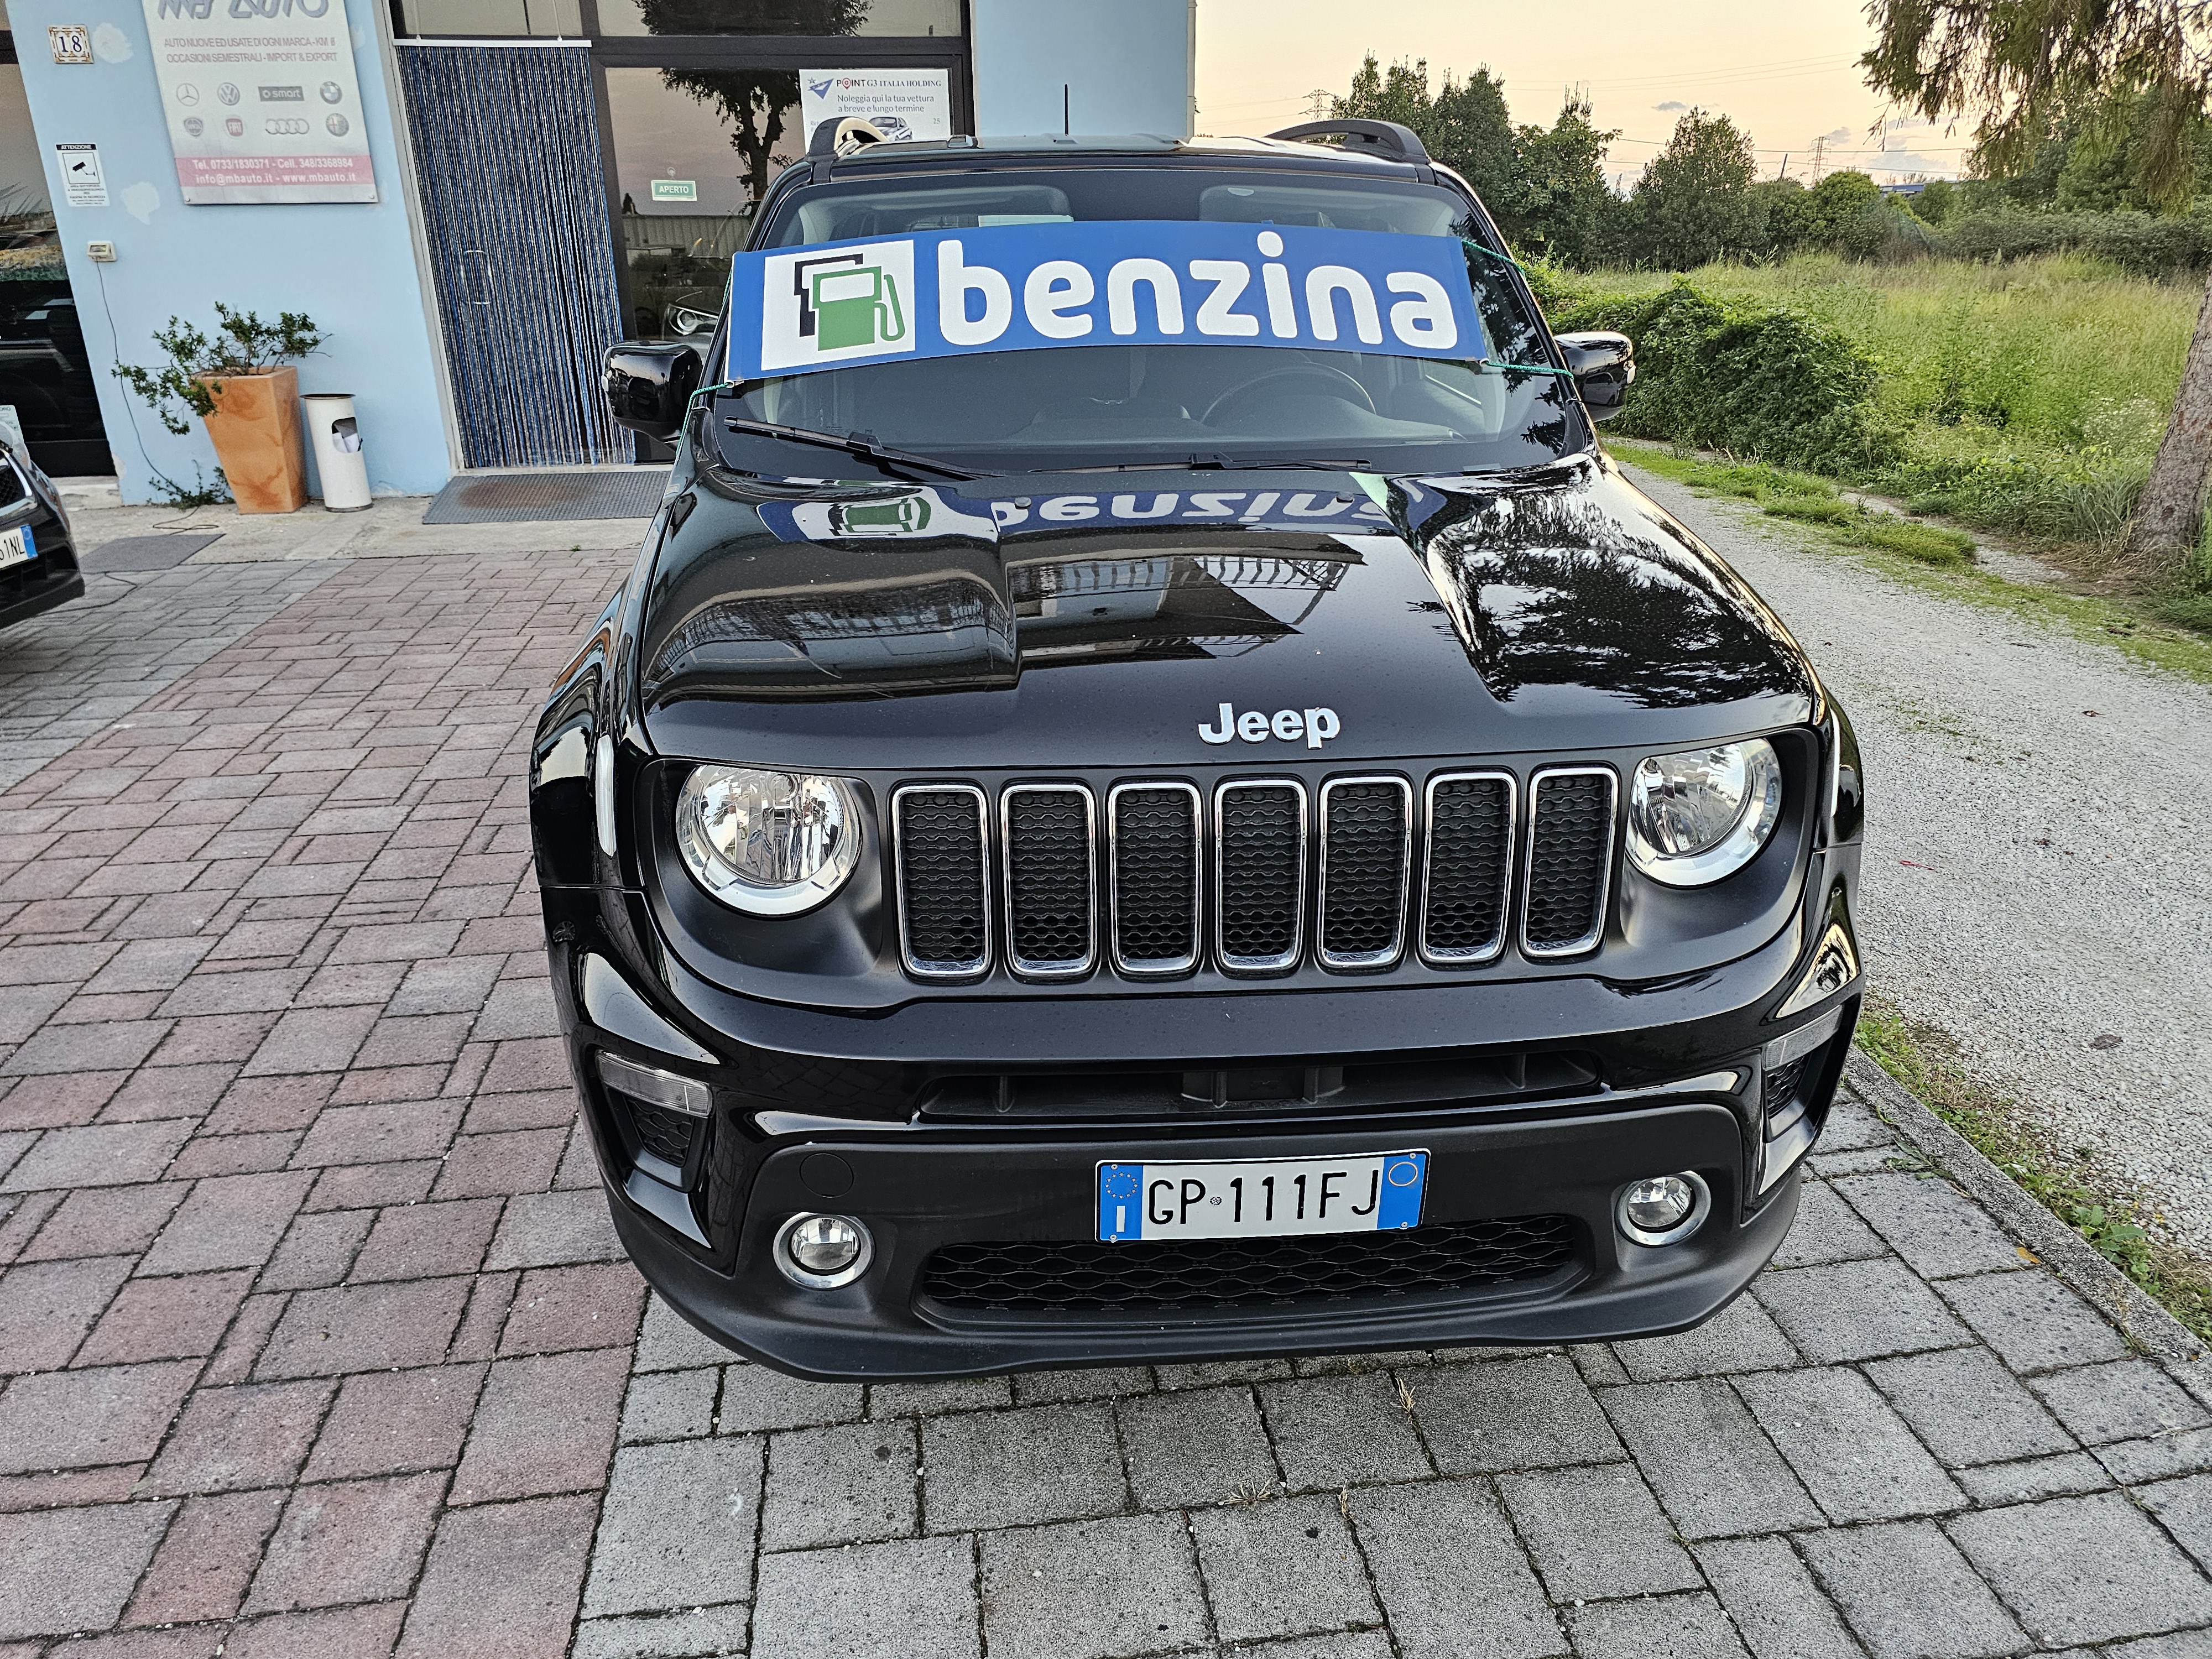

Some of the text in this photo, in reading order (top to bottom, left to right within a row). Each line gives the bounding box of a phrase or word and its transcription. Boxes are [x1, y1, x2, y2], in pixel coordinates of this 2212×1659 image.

[59, 35, 82, 53] 18
[165, 38, 186, 48] AUTO
[186, 38, 215, 47] NUOVE
[215, 38, 226, 47] ED
[227, 38, 253, 46] USATE
[253, 37, 262, 46] DI
[262, 37, 281, 46] OGNI
[283, 36, 312, 46] MARCA
[166, 53, 211, 62] OCCASIONI
[212, 53, 262, 62] SEMESTRALI
[266, 53, 296, 61] IMPORT
[299, 53, 305, 61] &
[305, 53, 337, 61] EXPORT
[837, 77, 865, 90] POINT
[272, 89, 301, 98] smart
[837, 94, 870, 103] Noleggia
[872, 94, 884, 103] qui
[873, 105, 894, 113] lungo
[191, 159, 209, 170] Tel.
[210, 159, 269, 170] 0733/1830371
[277, 158, 298, 169] Cell.
[299, 158, 353, 168] 348/3368984
[196, 173, 273, 185] info@mbauto.it
[282, 172, 356, 182] www.mbauto.it
[659, 185, 689, 194] APERTO
[938, 232, 1458, 349] benzina
[1198, 703, 1340, 750] Jeep
